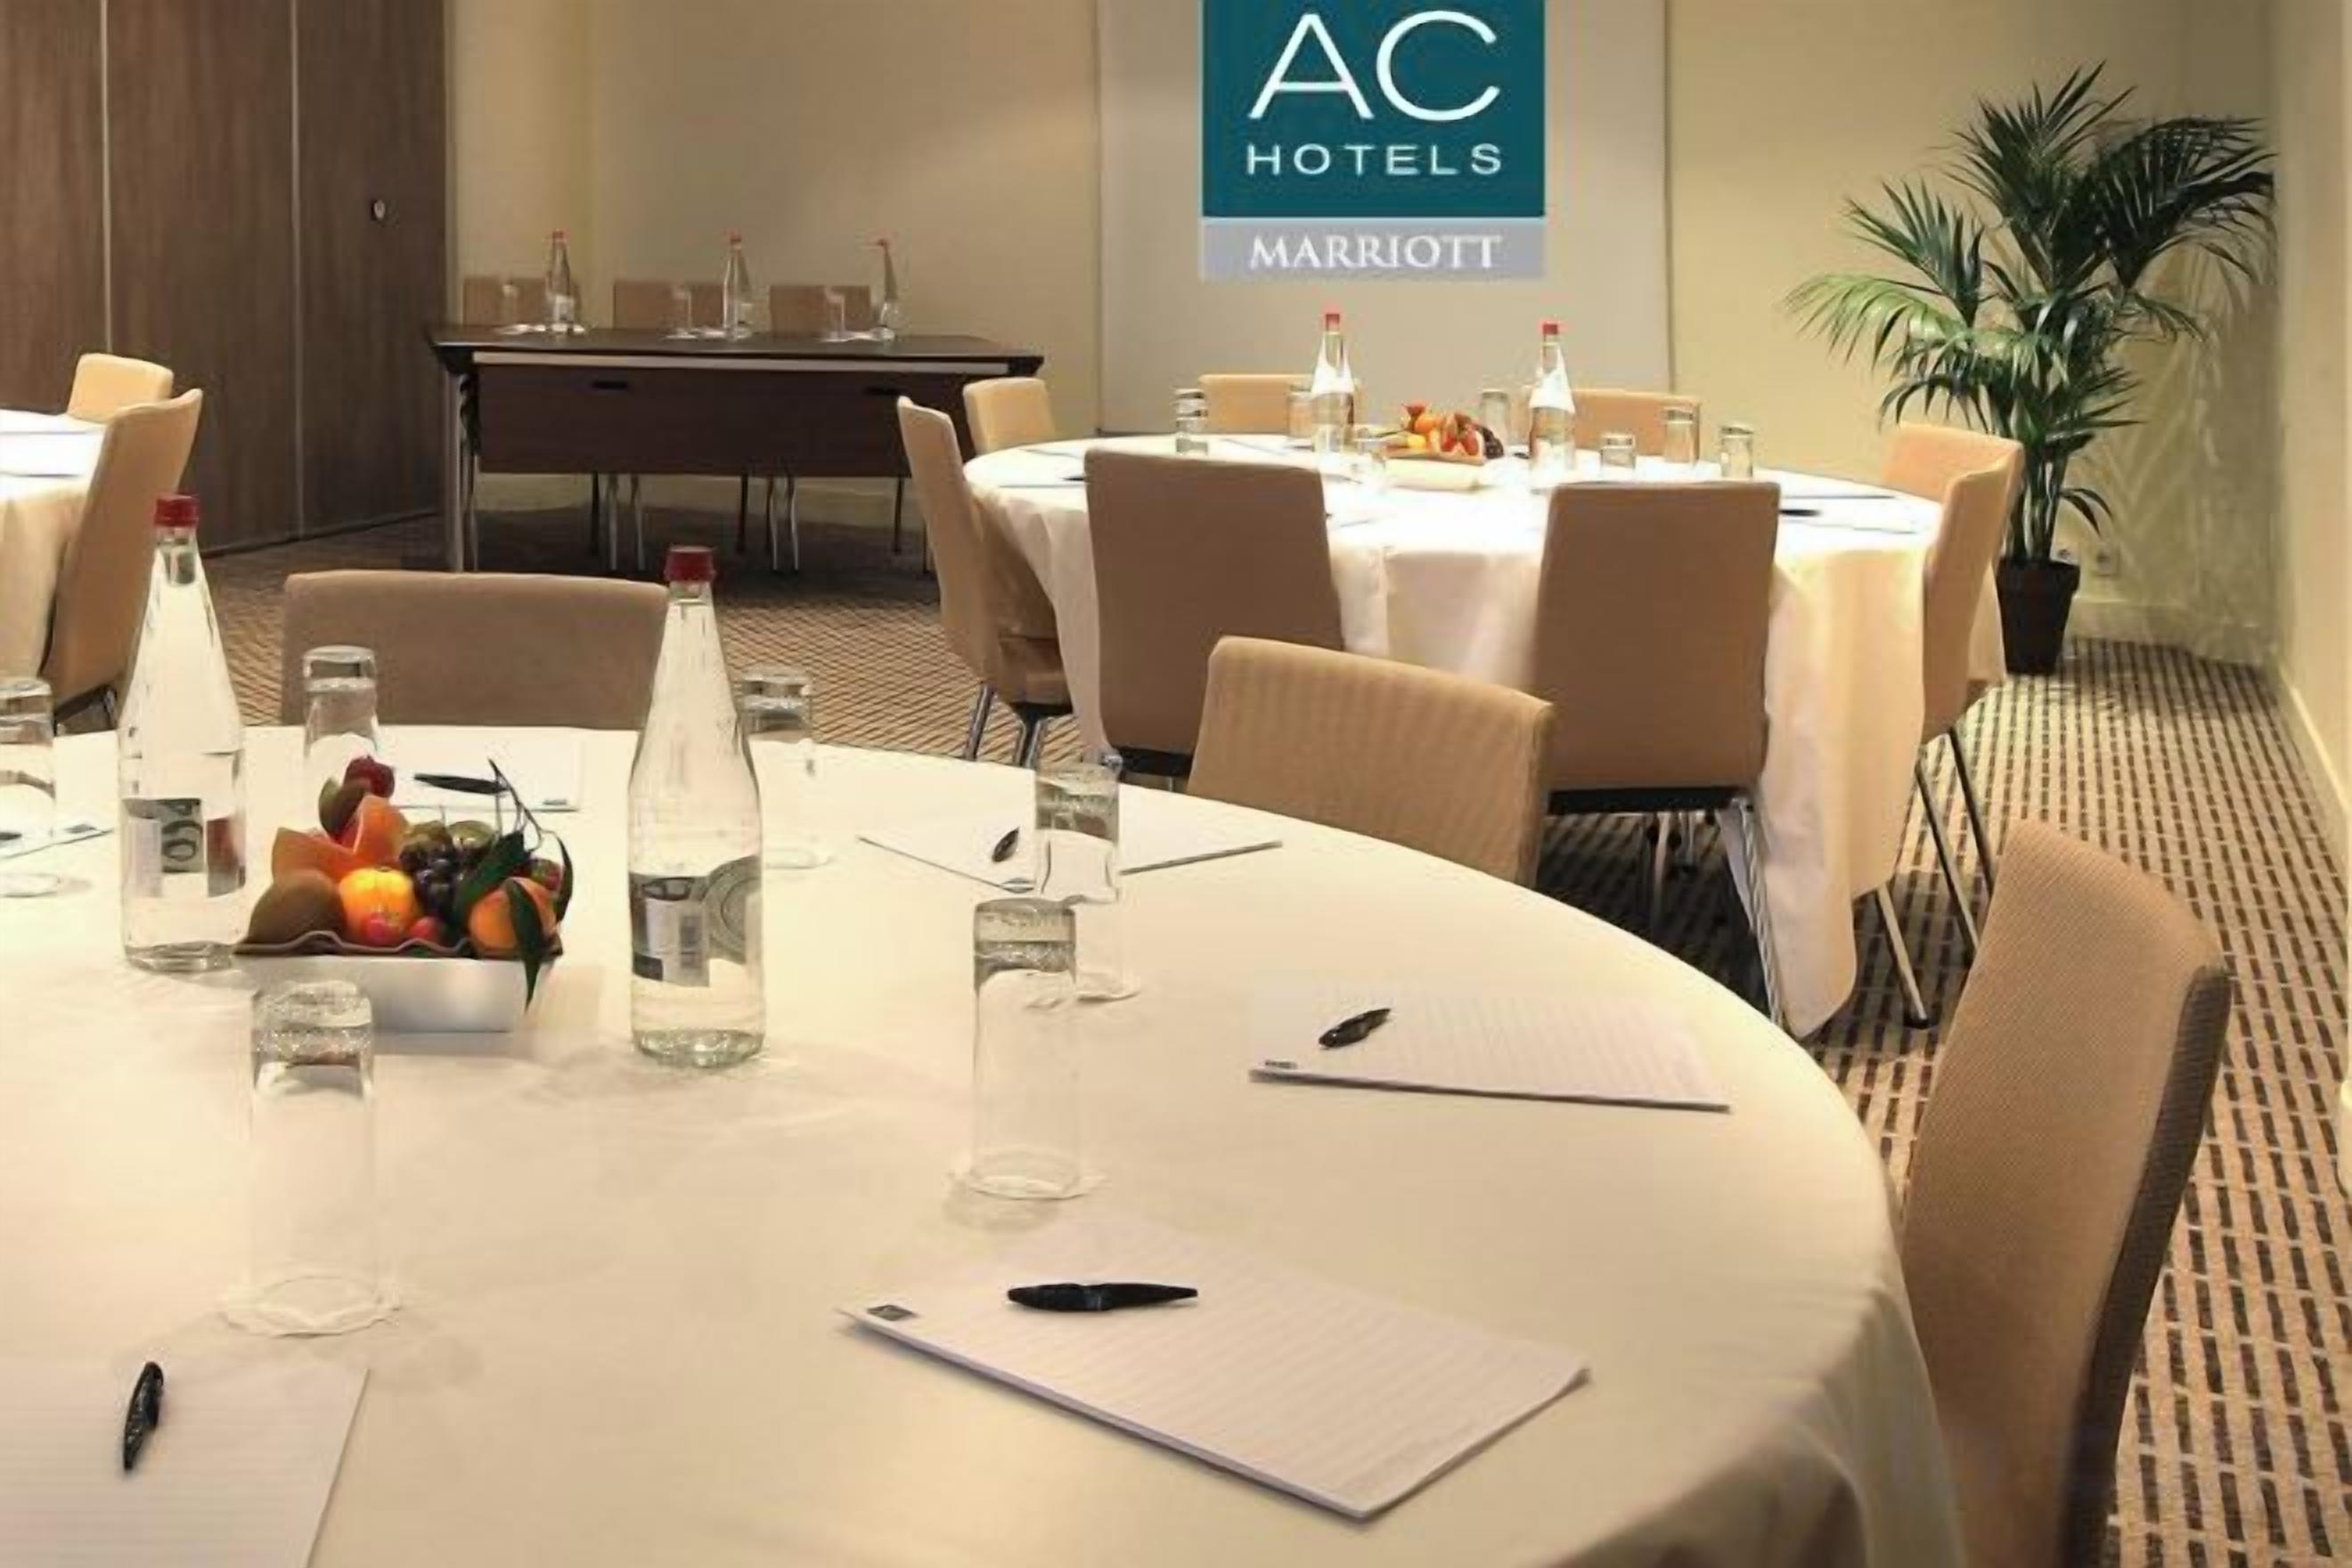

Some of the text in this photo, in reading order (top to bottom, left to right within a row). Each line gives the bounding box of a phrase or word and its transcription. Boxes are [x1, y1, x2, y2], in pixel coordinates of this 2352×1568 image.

[1248, 10, 1500, 121] AC
[1246, 143, 1502, 176] HOTELS
[1249, 234, 1502, 269] MARRIOTT
